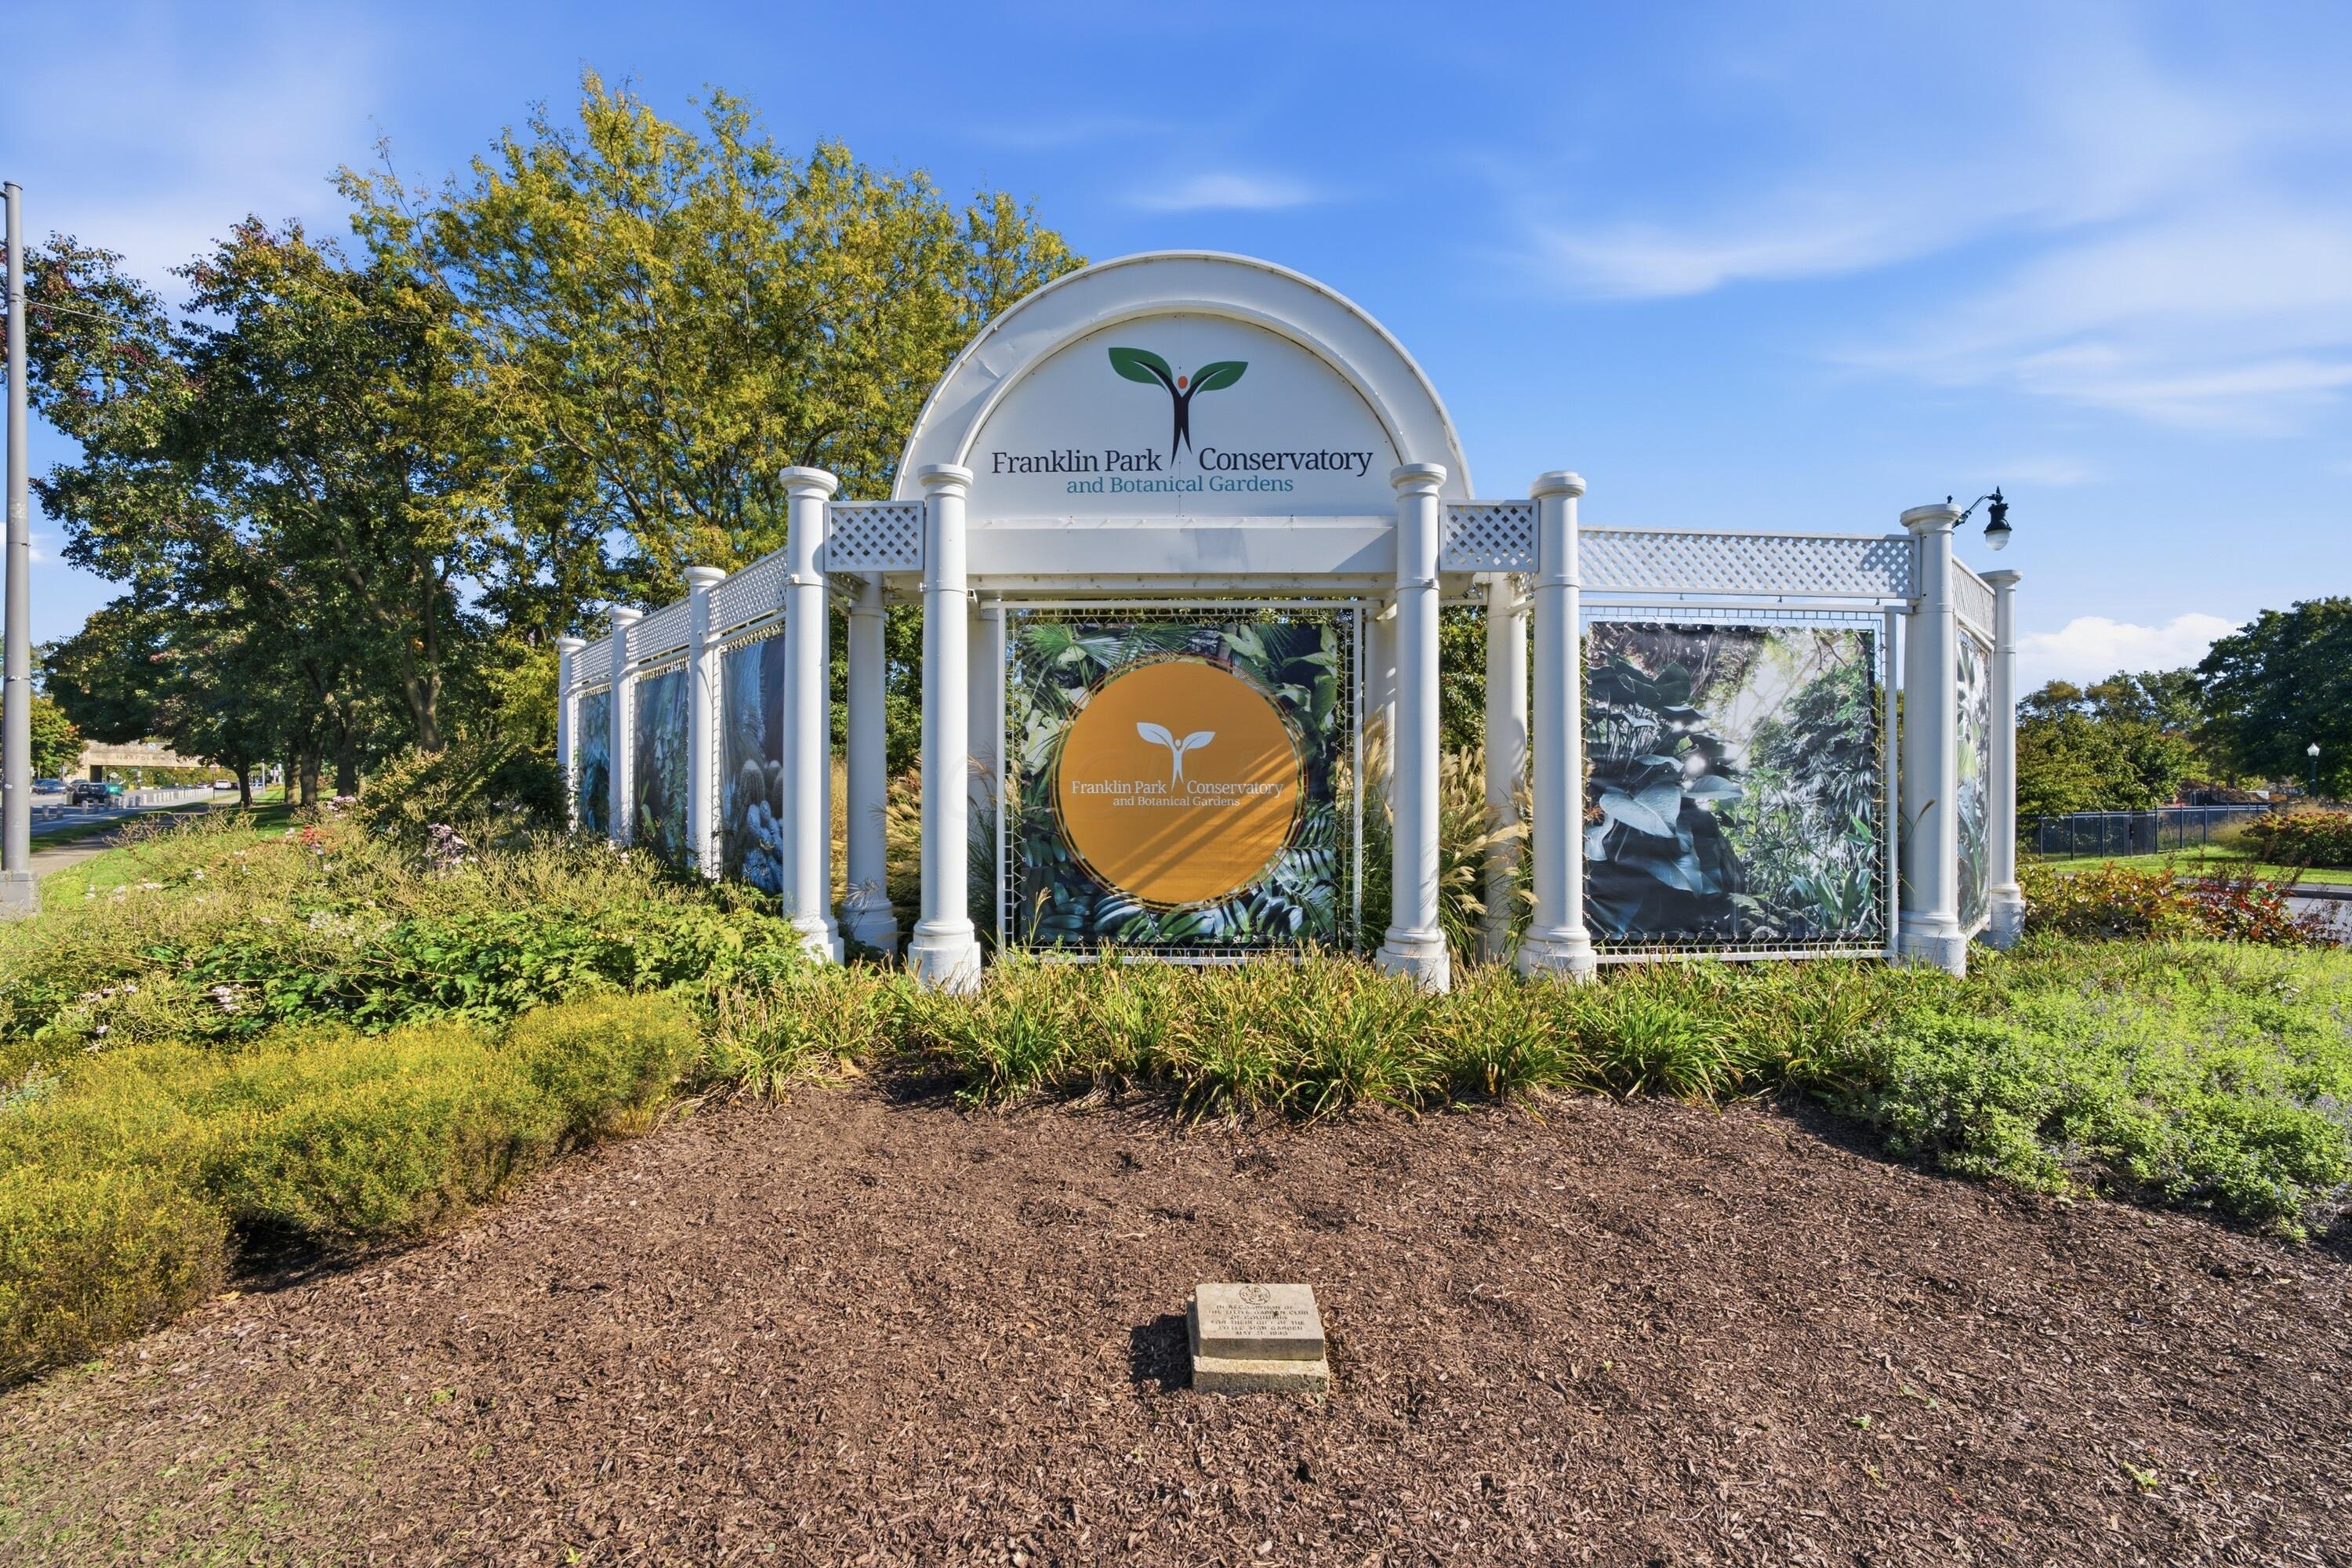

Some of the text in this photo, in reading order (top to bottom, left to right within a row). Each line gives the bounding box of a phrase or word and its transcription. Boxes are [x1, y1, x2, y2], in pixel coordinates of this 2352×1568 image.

[992, 448, 1374, 477] Franklin Park Conservatory
[1067, 475, 1294, 493] and Botanical Gardens
[1072, 780, 1284, 797] Franklin Park Conservatory
[1113, 797, 1240, 806] and Botanical Gardens
